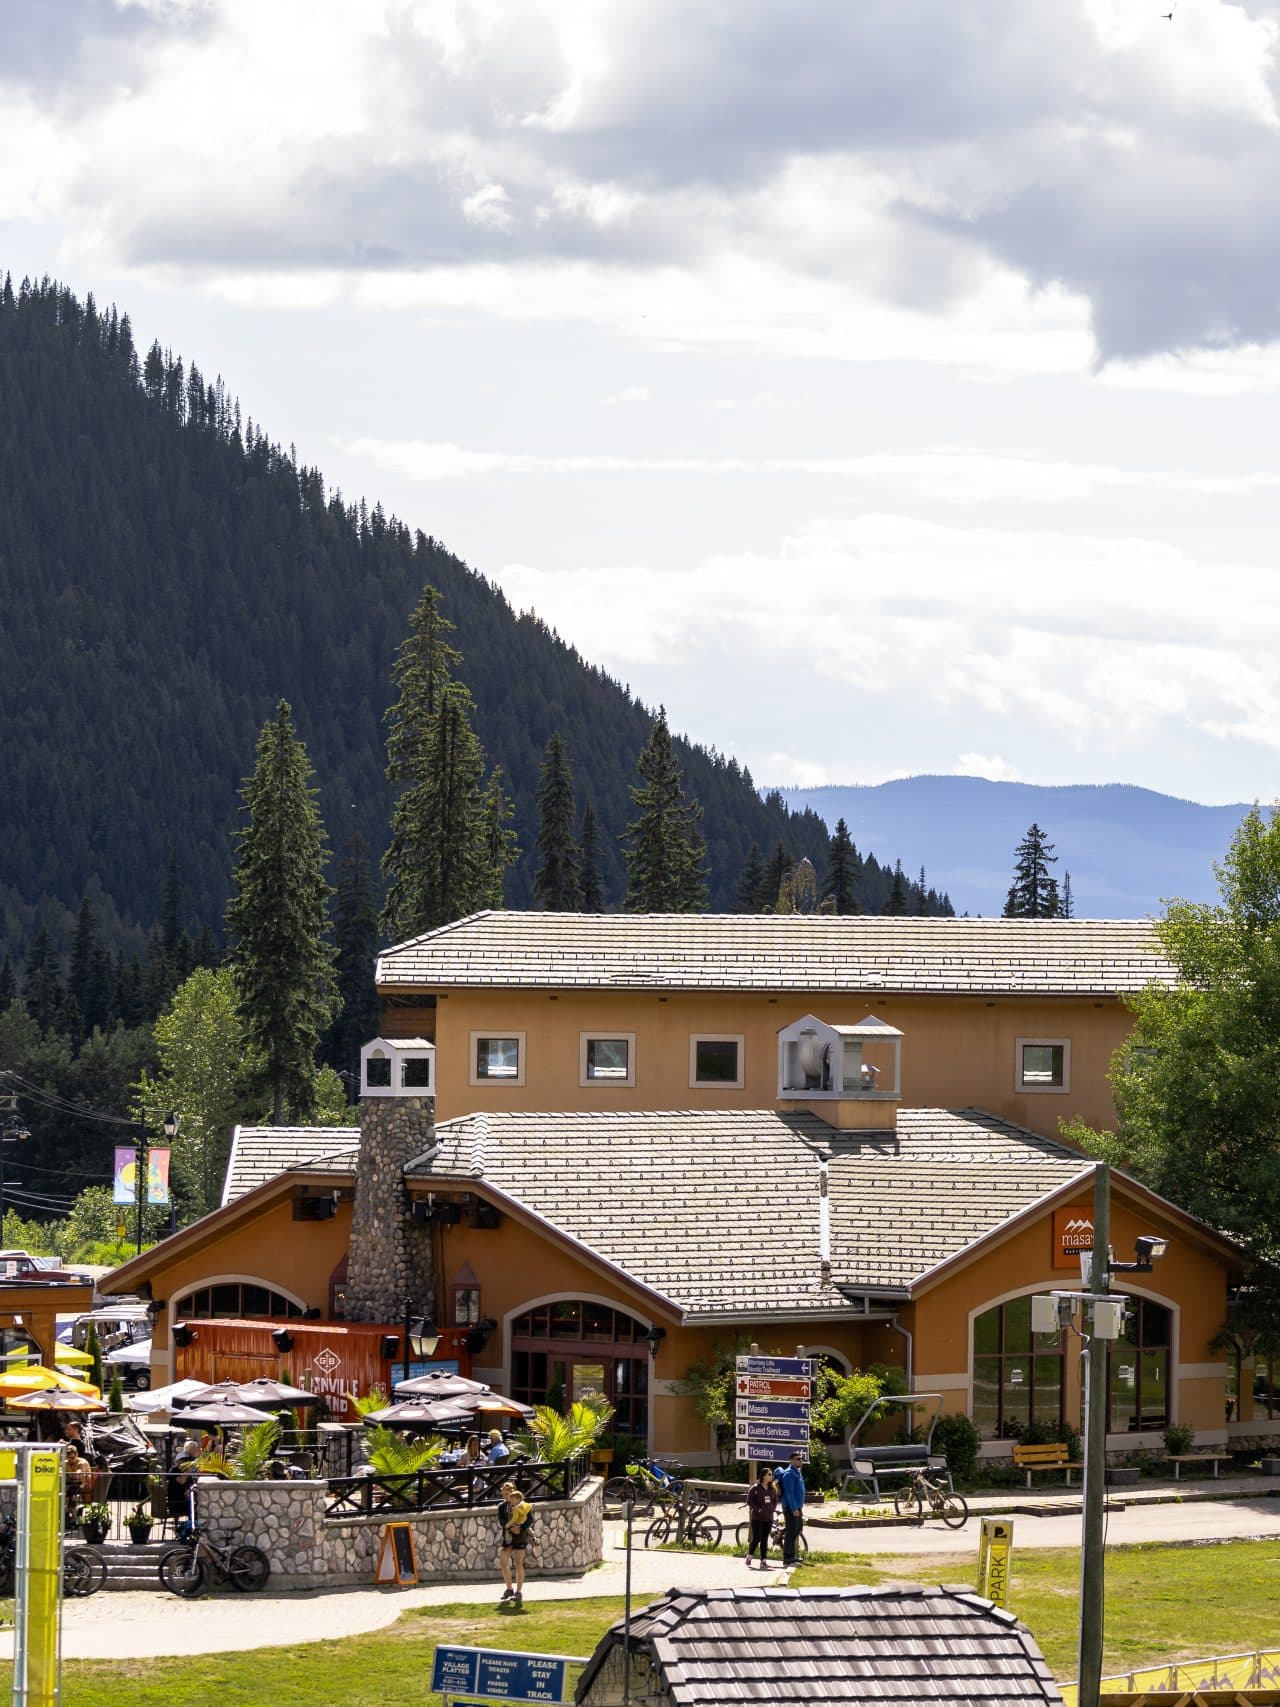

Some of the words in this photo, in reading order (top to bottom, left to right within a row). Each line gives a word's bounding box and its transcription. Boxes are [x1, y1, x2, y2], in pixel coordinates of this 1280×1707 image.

[1062, 1234, 1094, 1246] masa'
[749, 1381, 771, 1389] PATROL
[749, 1404, 768, 1414] Masa's
[748, 1426, 766, 1435] Guest
[766, 1427, 790, 1436] Services
[749, 1446, 774, 1459] Ticketing
[35, 1465, 55, 1473] bike
[990, 1556, 1006, 1601] PARK
[527, 1660, 557, 1669] PLEASE
[532, 1671, 551, 1679] STAY
[536, 1681, 545, 1689] IN
[527, 1691, 553, 1699] TRACK
